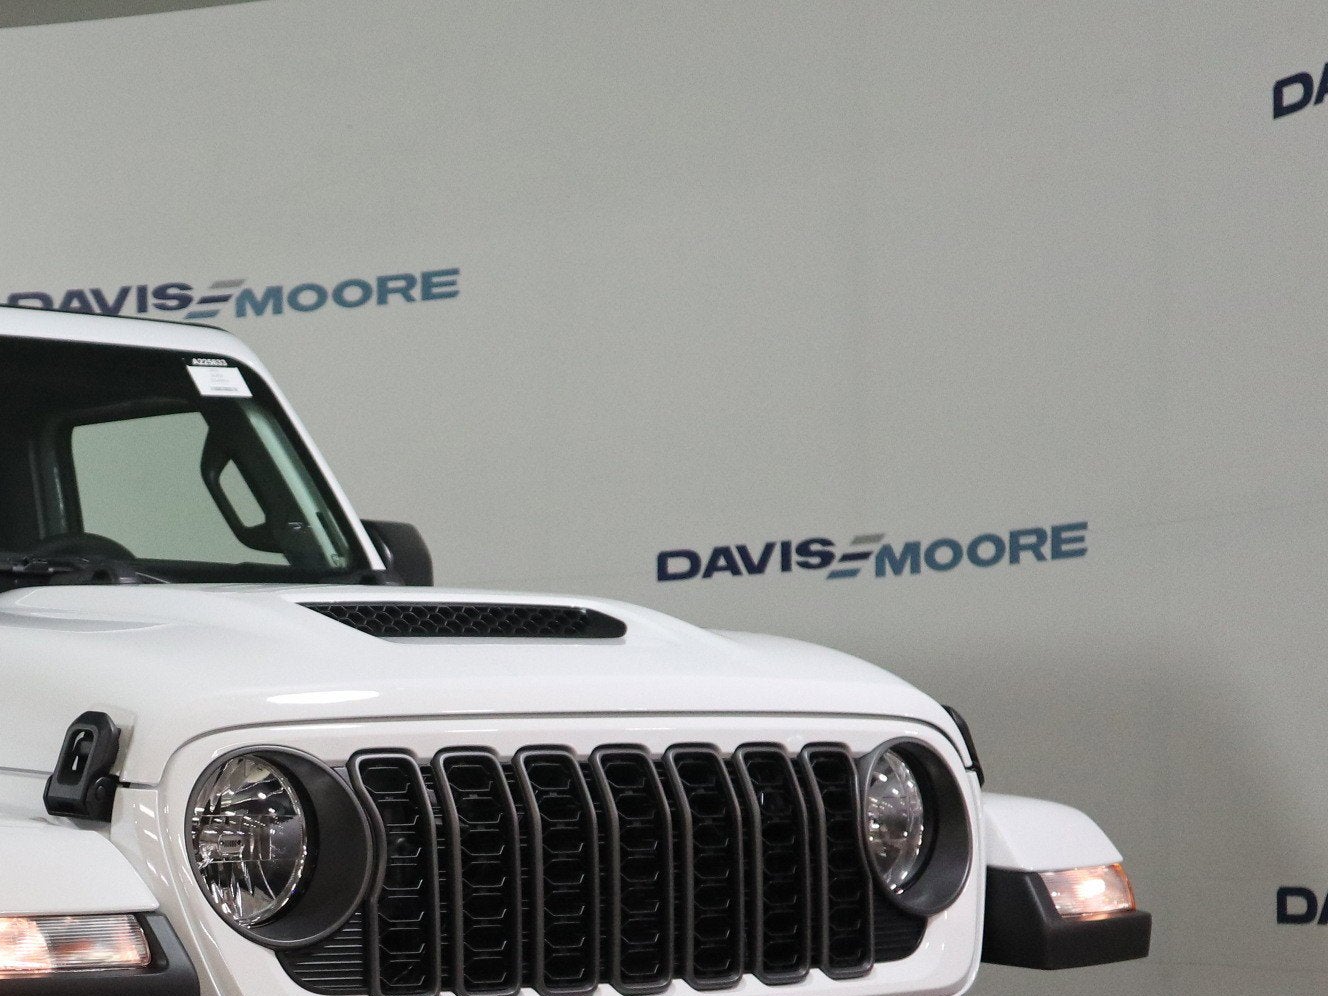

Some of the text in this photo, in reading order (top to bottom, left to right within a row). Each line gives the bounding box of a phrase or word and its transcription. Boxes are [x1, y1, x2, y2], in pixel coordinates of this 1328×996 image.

[235, 267, 461, 319] MOORE
[657, 521, 1089, 582] DAVIS MOORE
